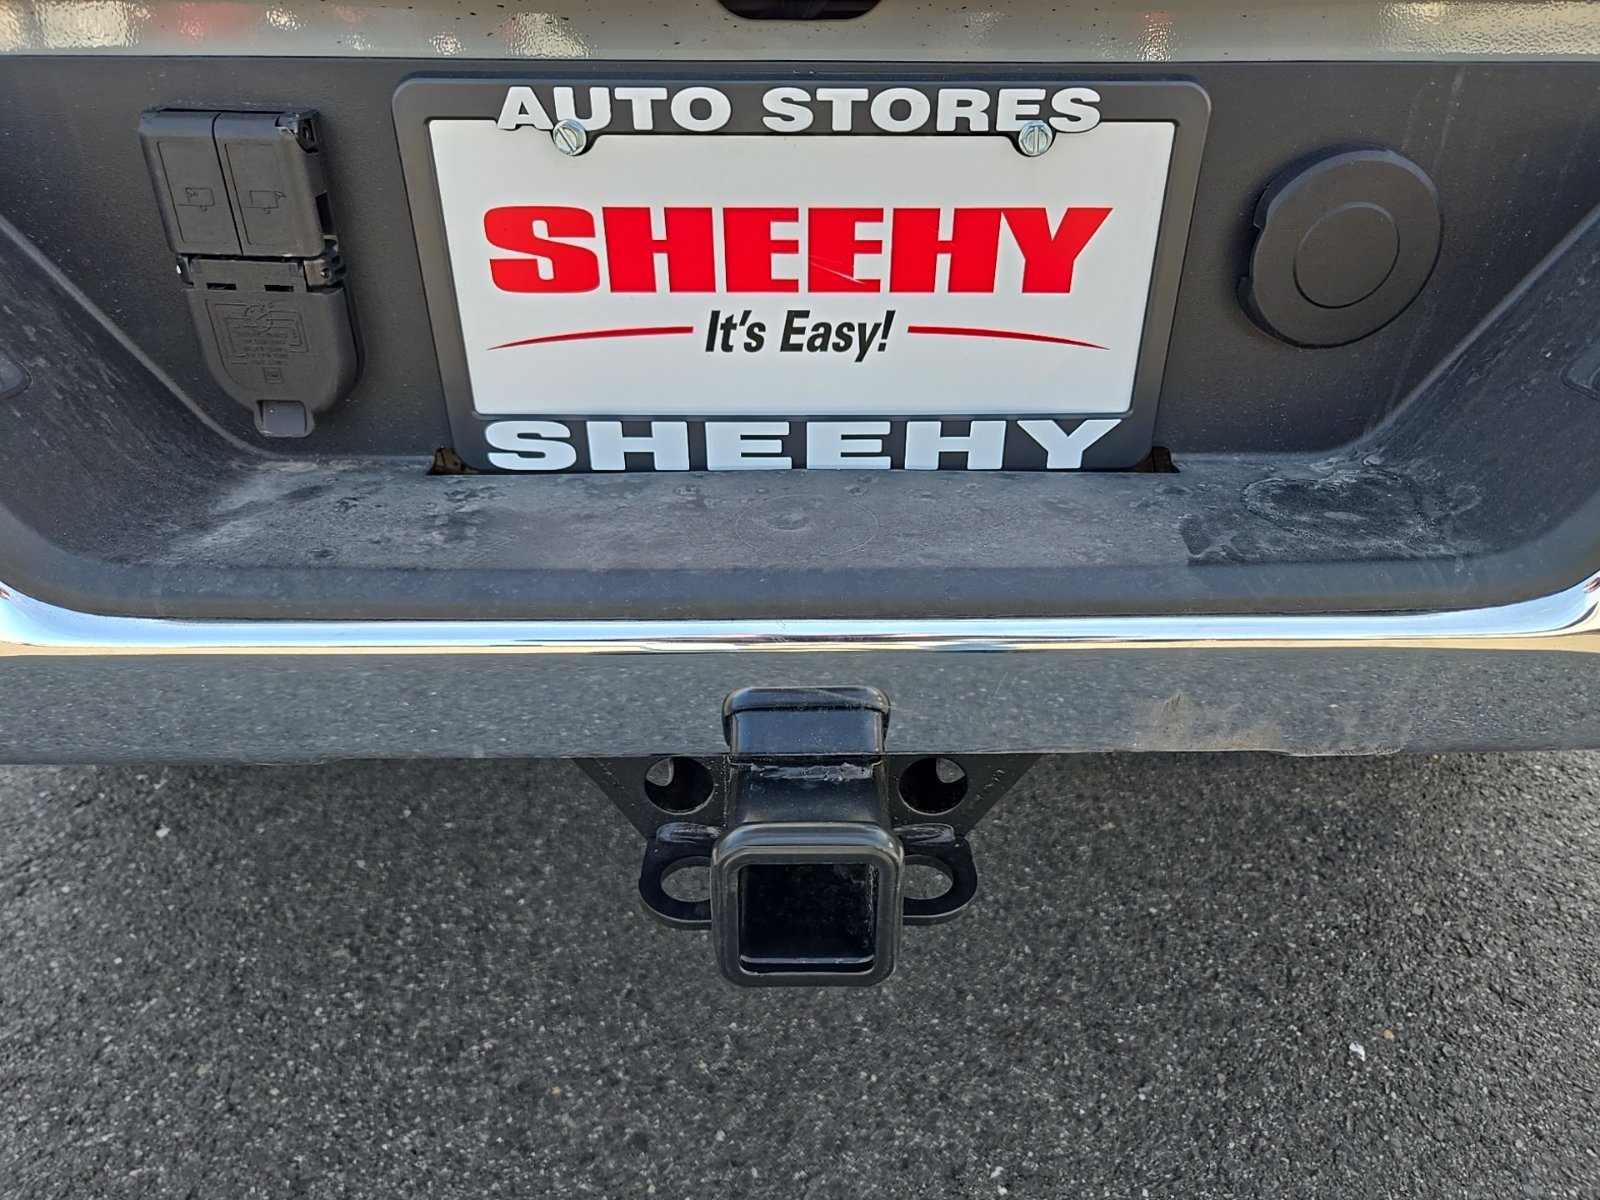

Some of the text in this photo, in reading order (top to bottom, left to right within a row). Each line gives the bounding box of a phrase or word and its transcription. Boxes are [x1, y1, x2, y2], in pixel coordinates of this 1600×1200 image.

[497, 86, 1101, 133] AUTO STORES
[484, 205, 1114, 294] SHEEHY
[705, 310, 896, 363] It's Easy!
[485, 418, 1122, 471] SHEEHY
